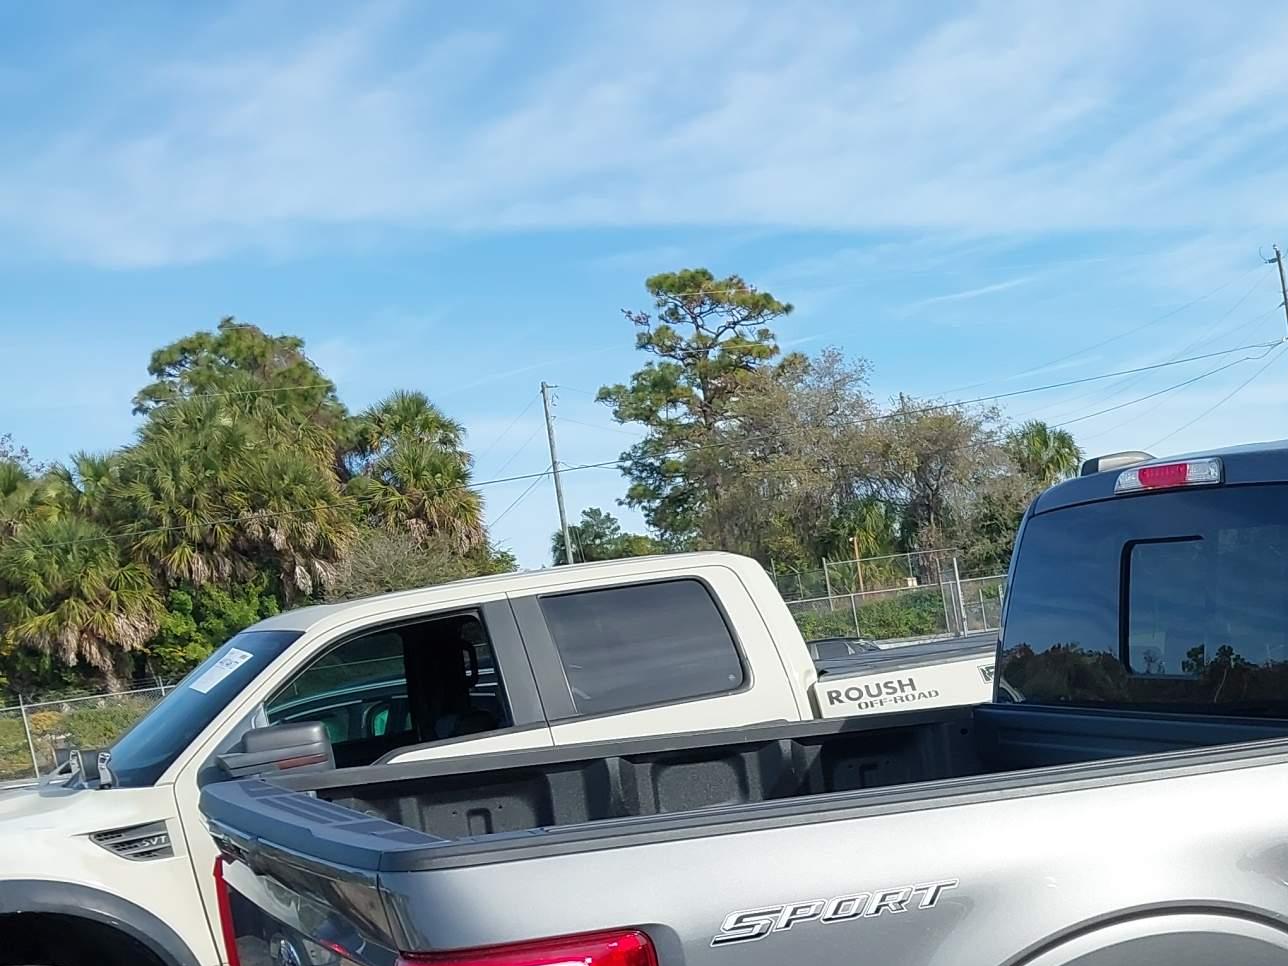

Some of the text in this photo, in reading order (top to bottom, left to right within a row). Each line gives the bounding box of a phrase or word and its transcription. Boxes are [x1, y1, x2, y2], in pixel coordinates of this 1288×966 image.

[826, 677, 917, 705] ROUSH
[857, 689, 940, 711] OFF-ROAD
[141, 835, 168, 847] SVT
[710, 878, 960, 947] SPORT
